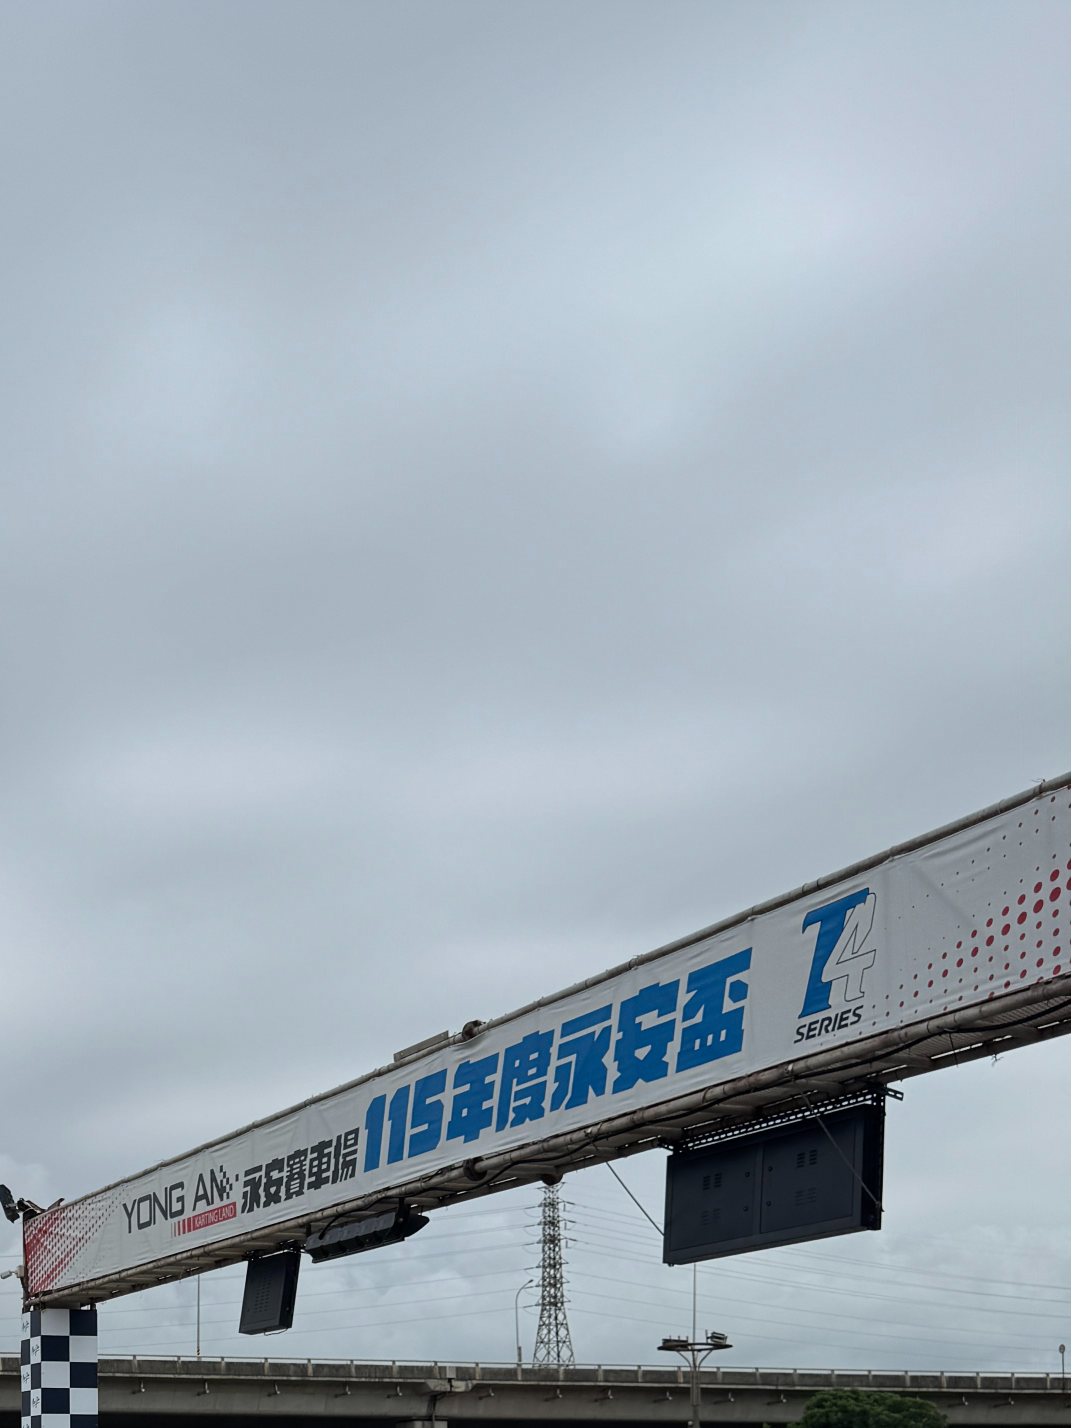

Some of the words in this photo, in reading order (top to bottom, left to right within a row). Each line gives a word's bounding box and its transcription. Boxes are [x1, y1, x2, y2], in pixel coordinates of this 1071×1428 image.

[794, 1005, 863, 1044] SERIES
[364, 947, 752, 1173] 115年度永安盃
[123, 1182, 184, 1234] YONG
[192, 1165, 233, 1212] AN
[242, 1127, 360, 1214] 永安賽車場
[194, 1210, 218, 1228] KARTING
[218, 1205, 235, 1220] LAND
